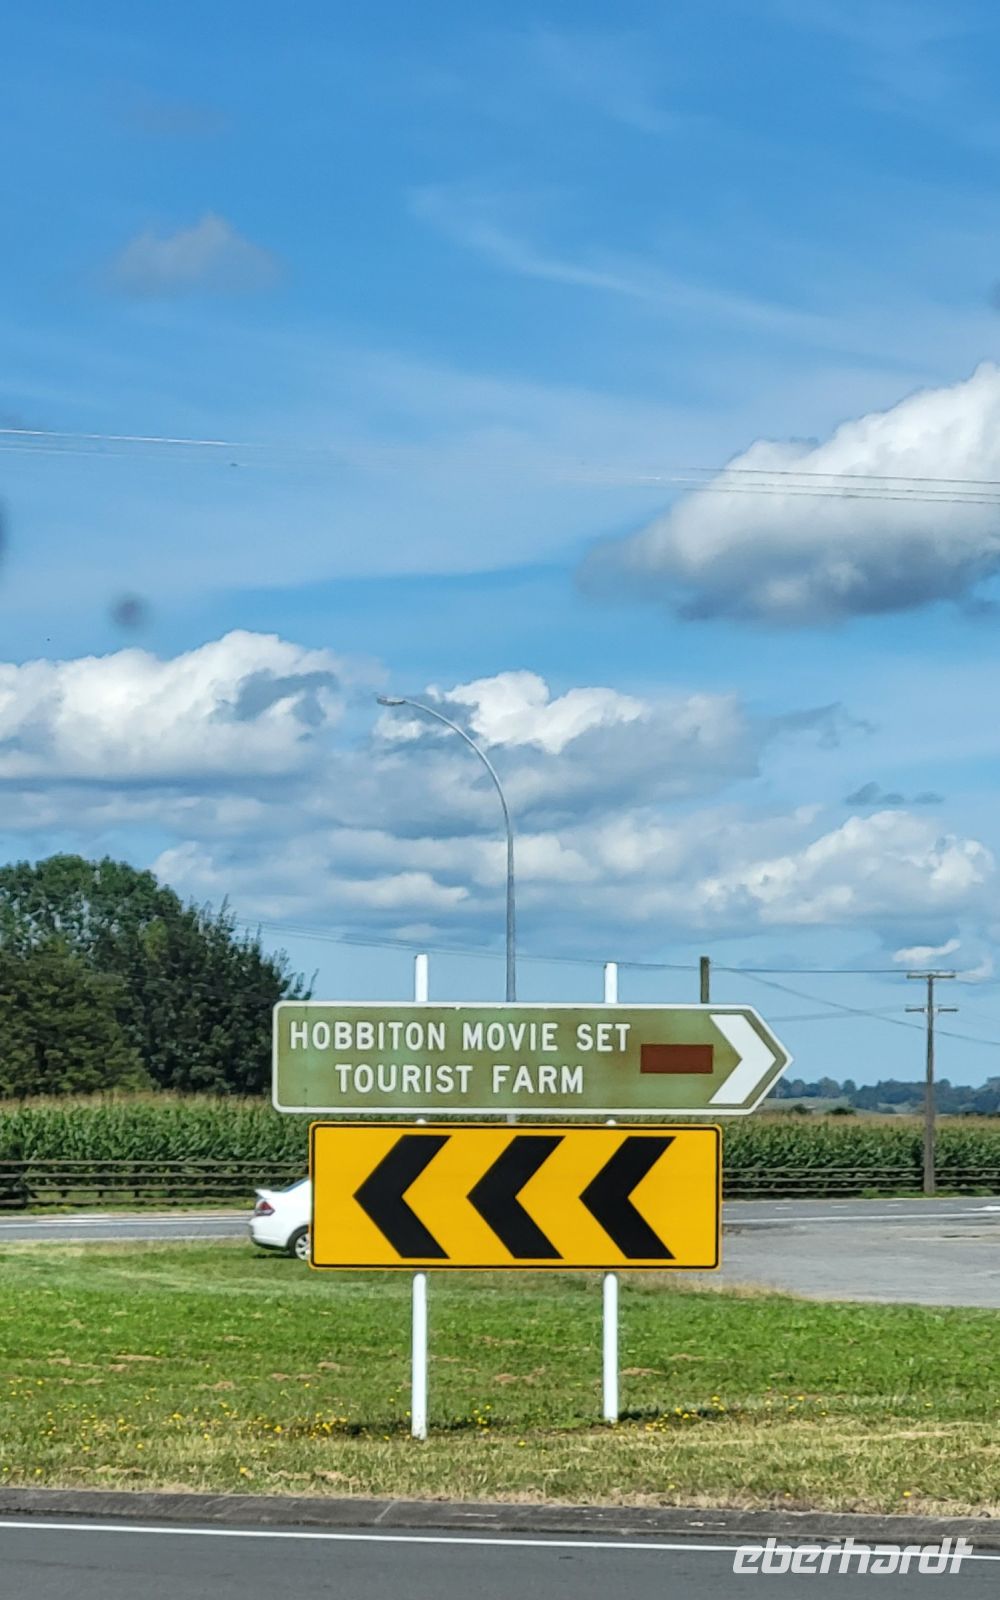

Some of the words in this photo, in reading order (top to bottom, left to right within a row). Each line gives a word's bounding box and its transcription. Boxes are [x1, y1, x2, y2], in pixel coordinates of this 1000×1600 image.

[290, 1021, 446, 1051] HOBBITON
[462, 1023, 559, 1052] MOVIE
[576, 1023, 631, 1053] SET
[335, 1064, 473, 1094] TOURIST
[493, 1065, 584, 1094] FARM
